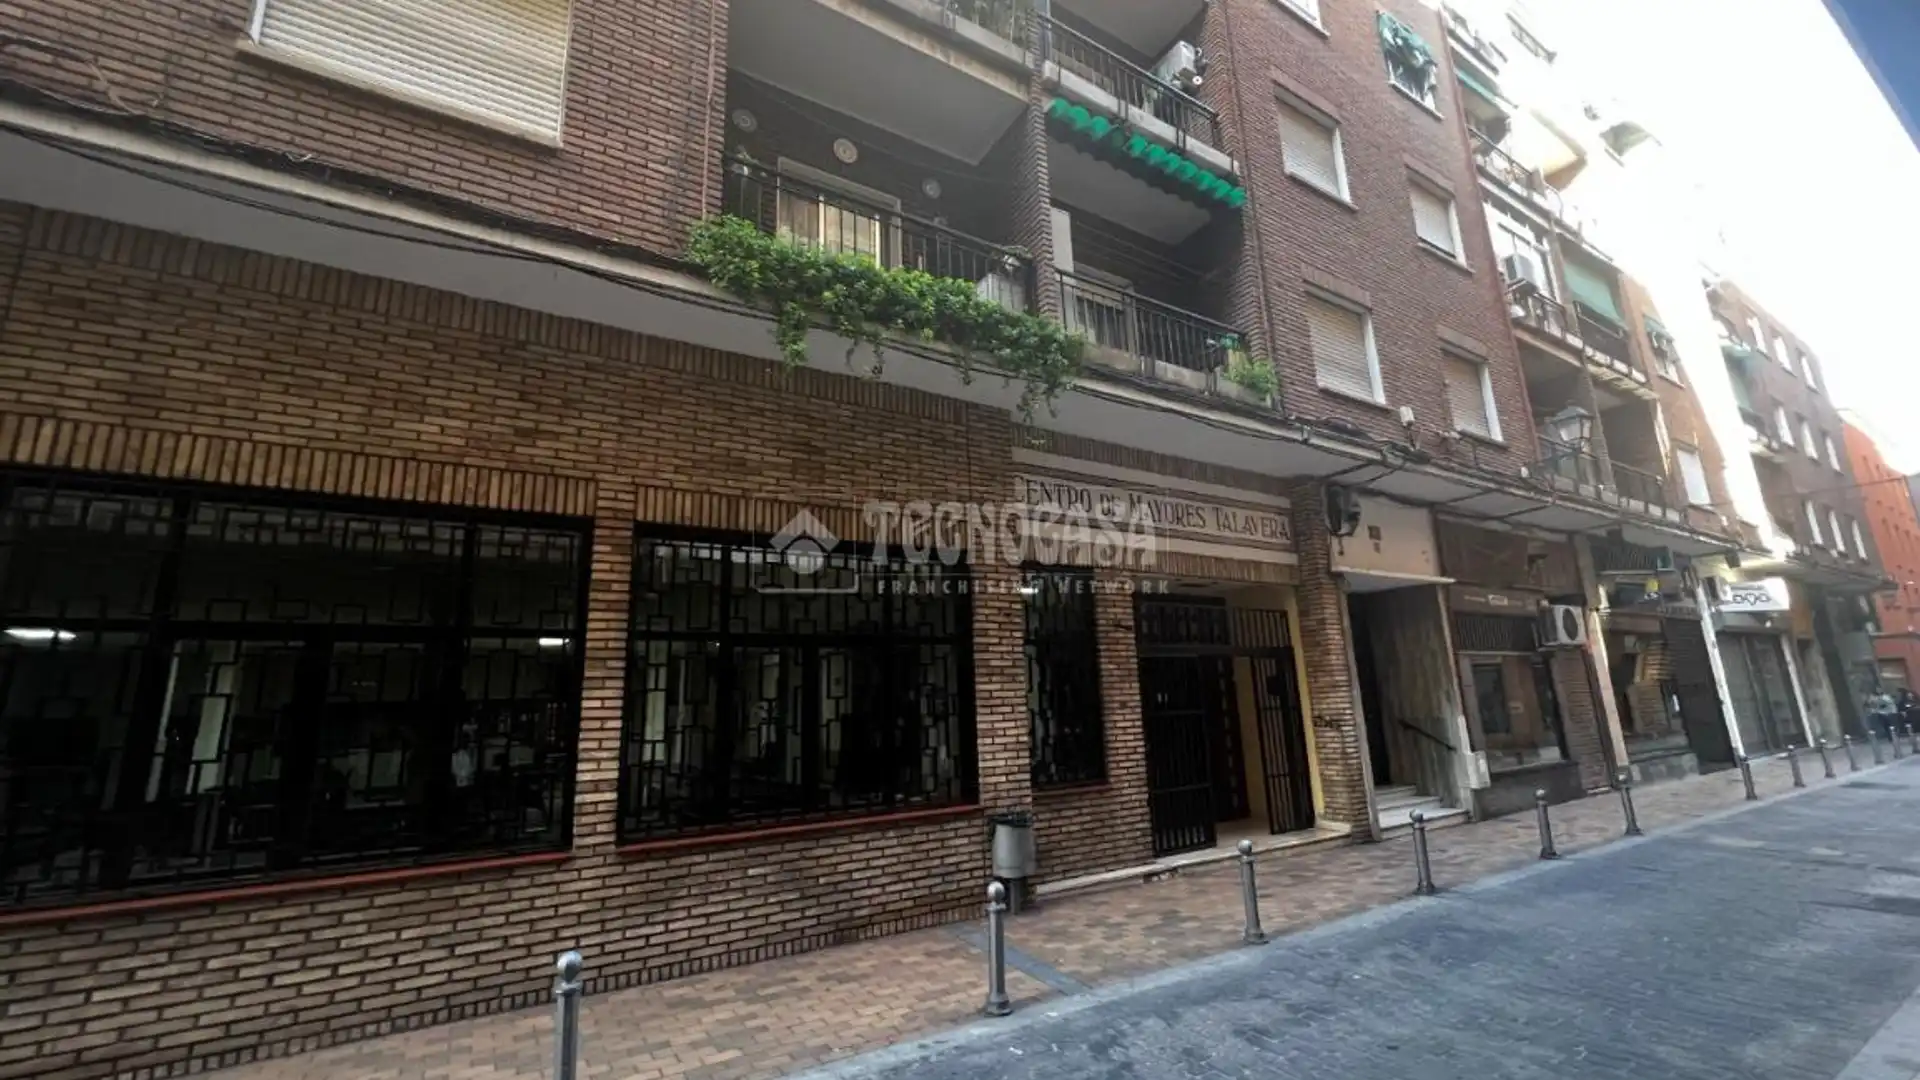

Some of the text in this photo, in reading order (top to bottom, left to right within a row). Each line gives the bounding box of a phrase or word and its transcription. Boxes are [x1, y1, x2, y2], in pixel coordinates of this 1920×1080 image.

[1099, 493, 1121, 517] DE
[1128, 492, 1206, 528] MAYORES
[1212, 507, 1291, 541] TALAVERA
